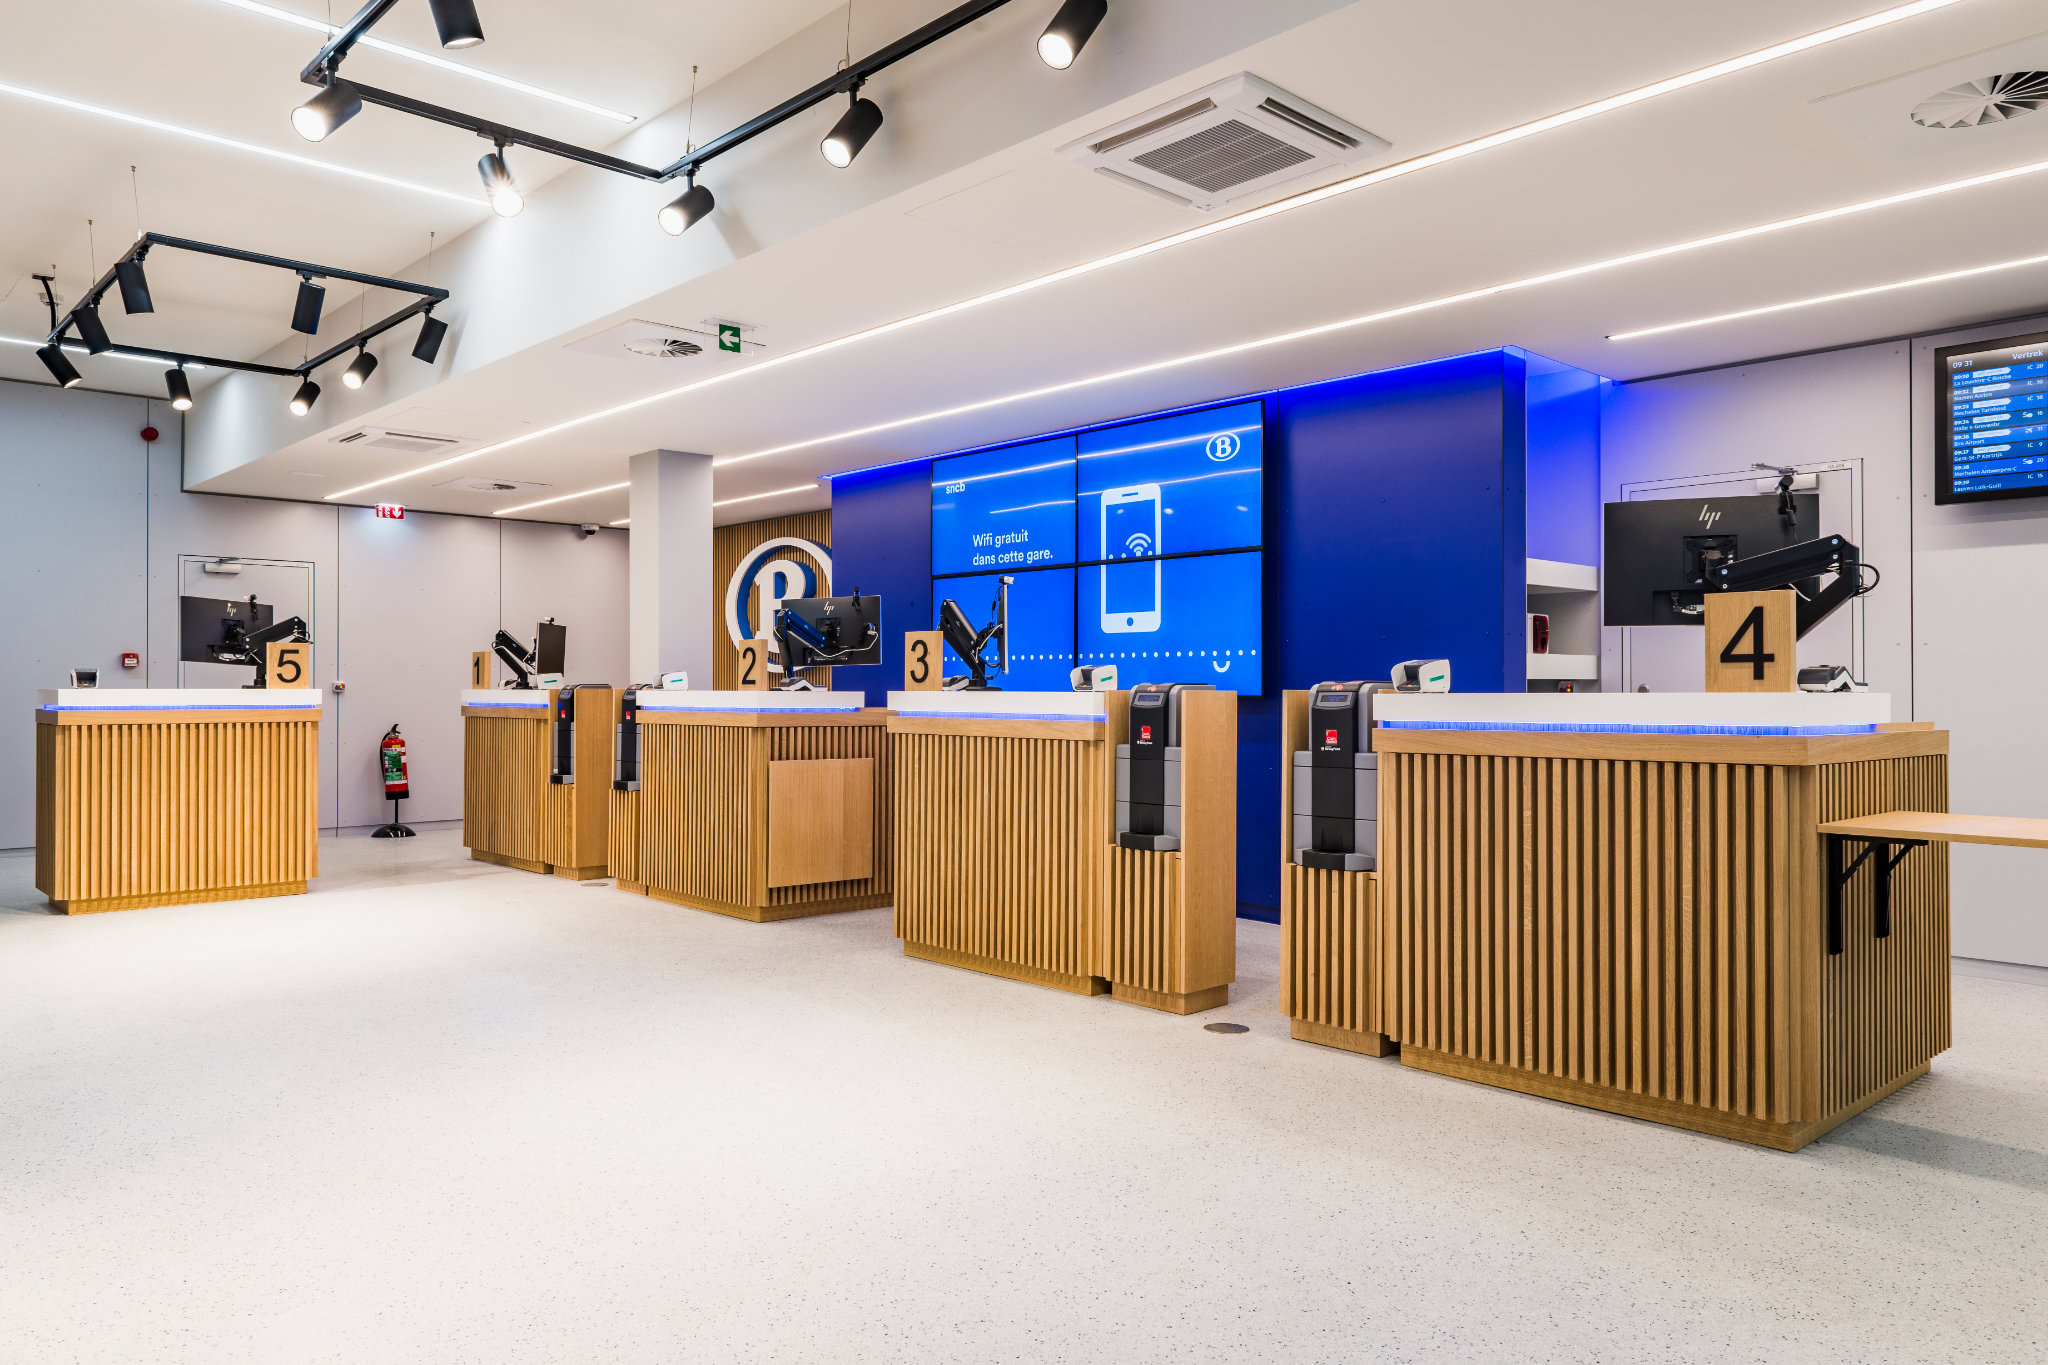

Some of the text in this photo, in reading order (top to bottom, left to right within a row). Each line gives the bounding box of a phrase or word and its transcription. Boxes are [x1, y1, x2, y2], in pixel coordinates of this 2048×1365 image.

[2012, 349, 2044, 360] Vertrek
[1965, 438, 1985, 446] Airport
[945, 481, 966, 494] sncb
[1698, 504, 1722, 530] hp
[972, 529, 1029, 548] Wifi gratuit
[972, 549, 1054, 566] dans cette gare.
[1719, 605, 1775, 681] 4
[276, 649, 302, 684] 5
[473, 656, 480, 686] 1
[741, 646, 757, 685] 2
[909, 639, 929, 684] 3
